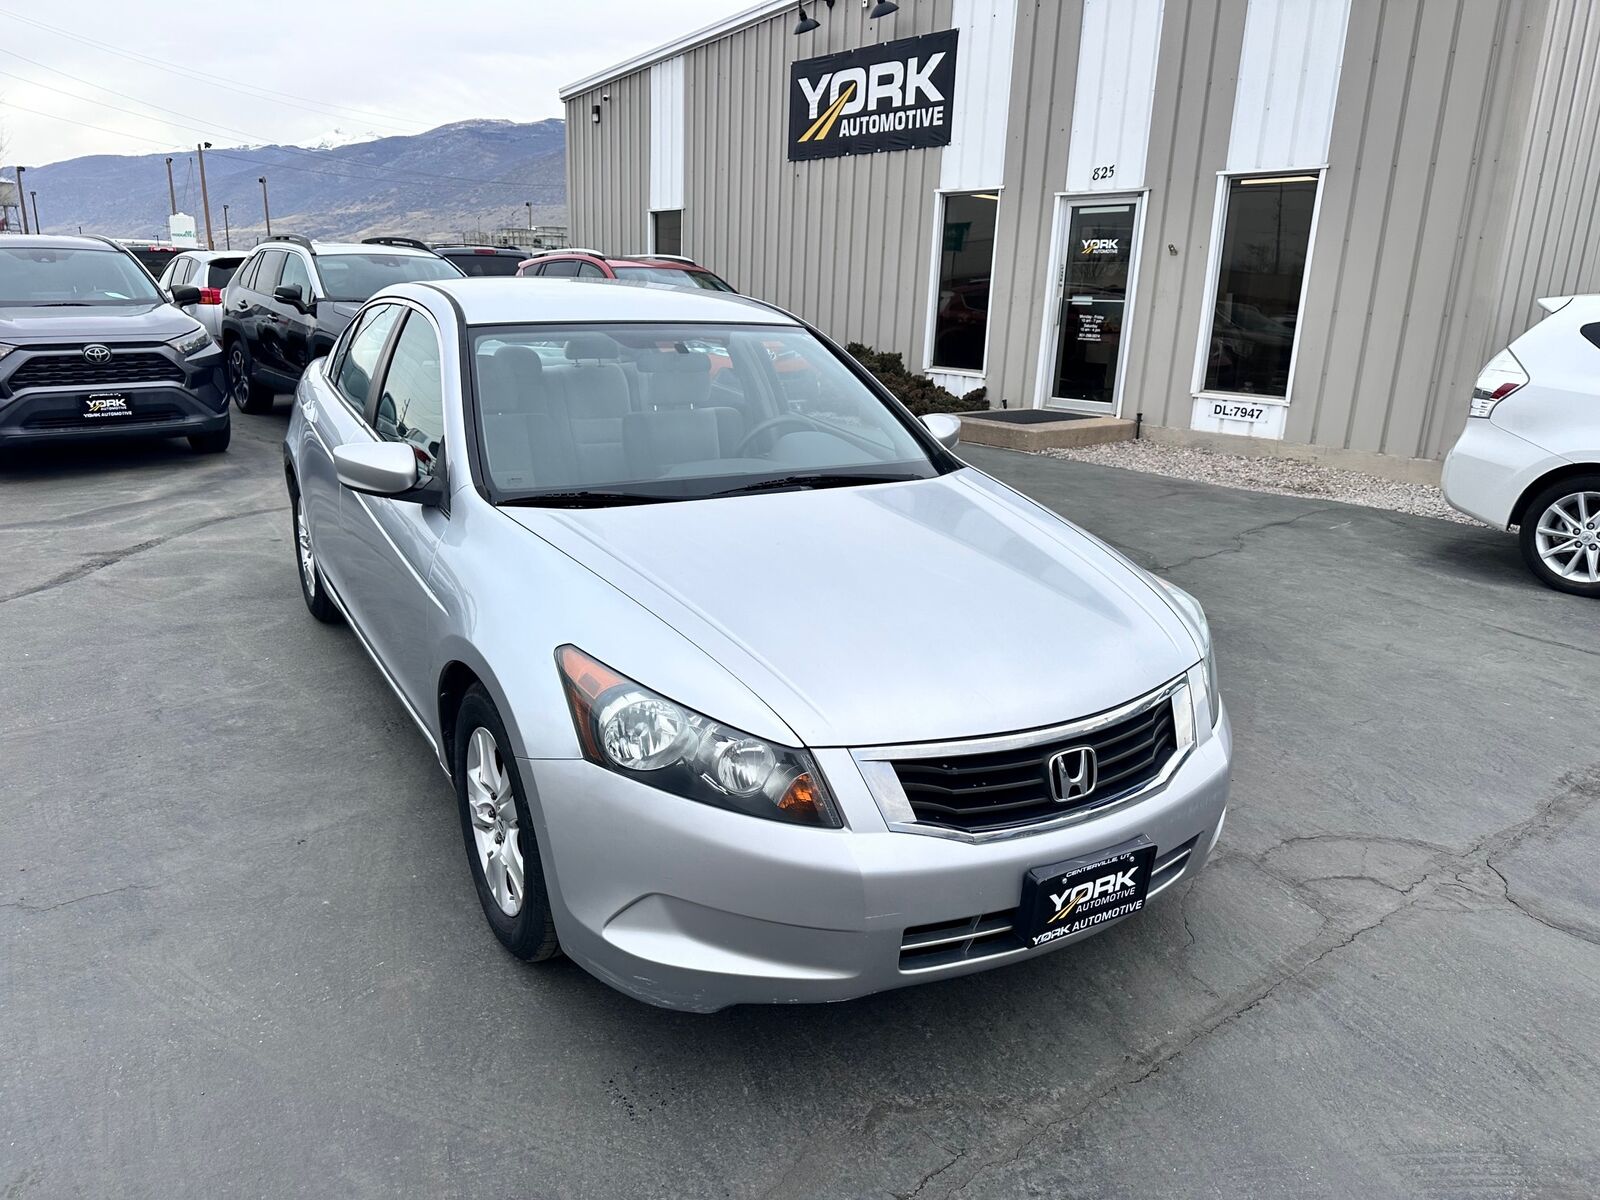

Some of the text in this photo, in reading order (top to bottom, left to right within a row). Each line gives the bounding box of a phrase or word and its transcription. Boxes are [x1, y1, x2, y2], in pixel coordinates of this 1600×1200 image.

[798, 51, 947, 120] YORK
[838, 105, 944, 138] AUTOMOTIVE
[1092, 164, 1115, 181] 825
[1081, 238, 1119, 249] YORK
[86, 399, 126, 408] YORK
[1213, 404, 1264, 420] DL:7947
[1120, 852, 1132, 860] UT
[1049, 866, 1139, 912] YORK
[1075, 886, 1136, 914] AUTOMOTIVE
[1032, 899, 1143, 945] YORK AUTOMOTIVE
